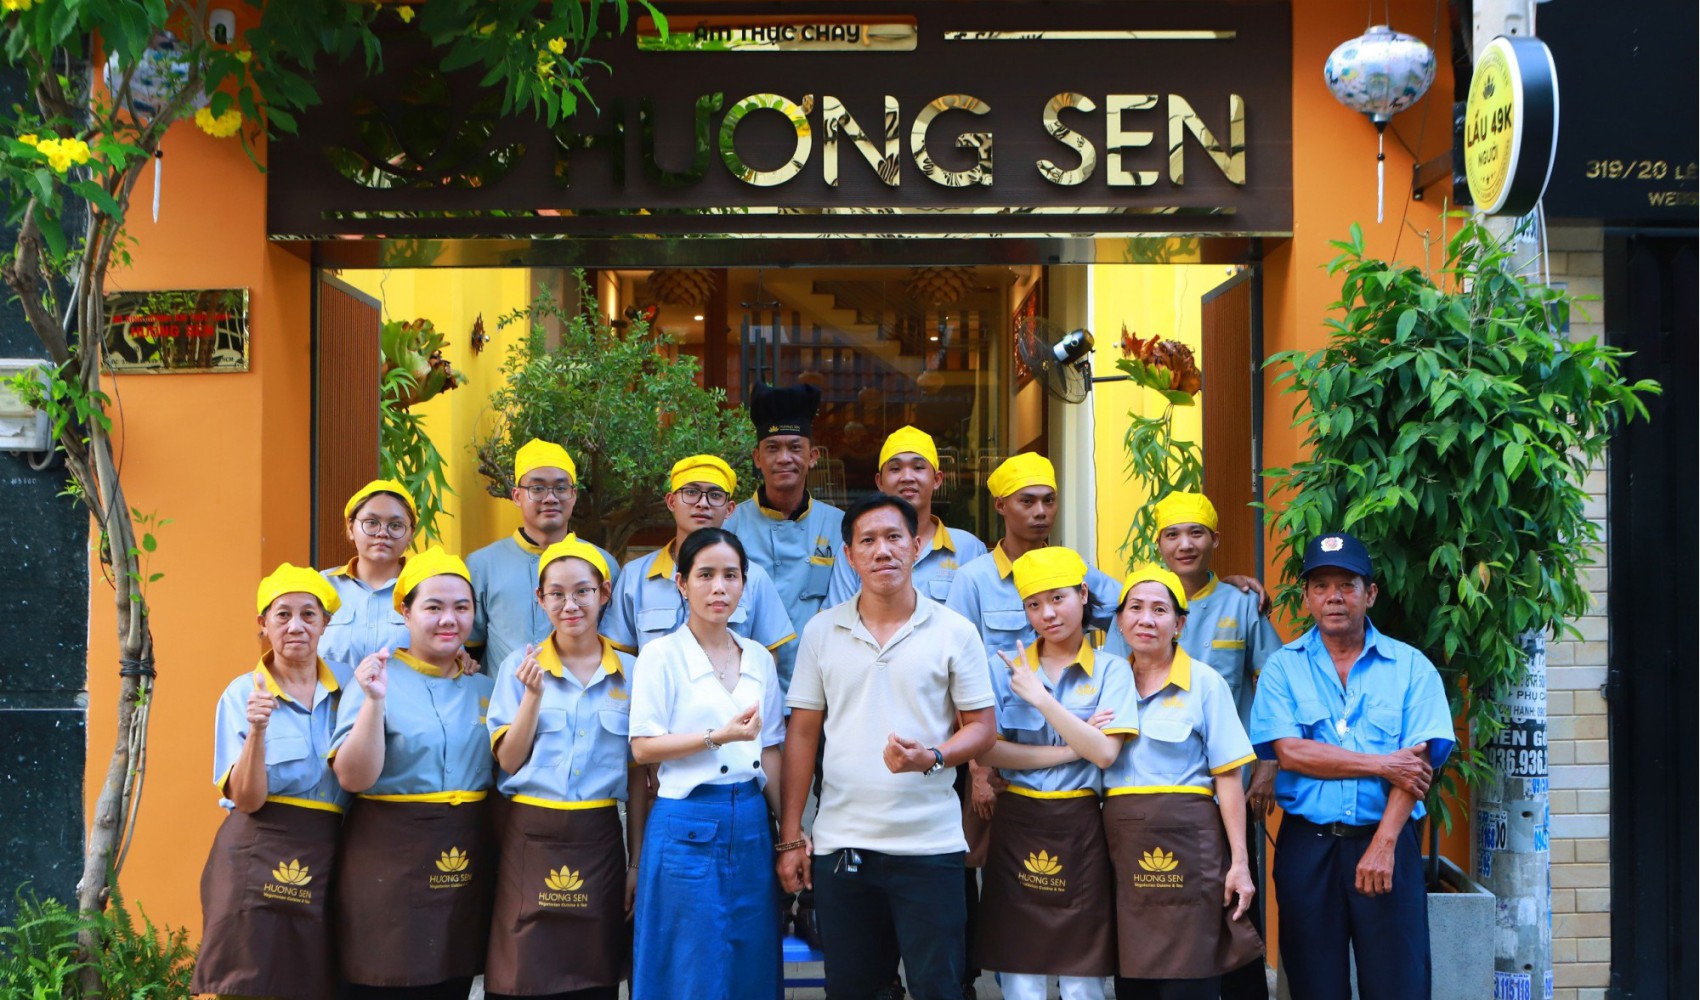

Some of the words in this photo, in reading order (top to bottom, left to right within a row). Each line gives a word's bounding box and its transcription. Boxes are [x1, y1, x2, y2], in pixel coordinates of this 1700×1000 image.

[1490, 103, 1512, 137] 49K
[555, 91, 993, 187] HƯƠNG
[1036, 93, 1246, 187] SEN
[1586, 160, 1668, 180] 319/20
[1050, 878, 1066, 887] SEN
[1167, 874, 1184, 882] SEN
[299, 889, 312, 899] SEN
[573, 893, 588, 902] SEN
